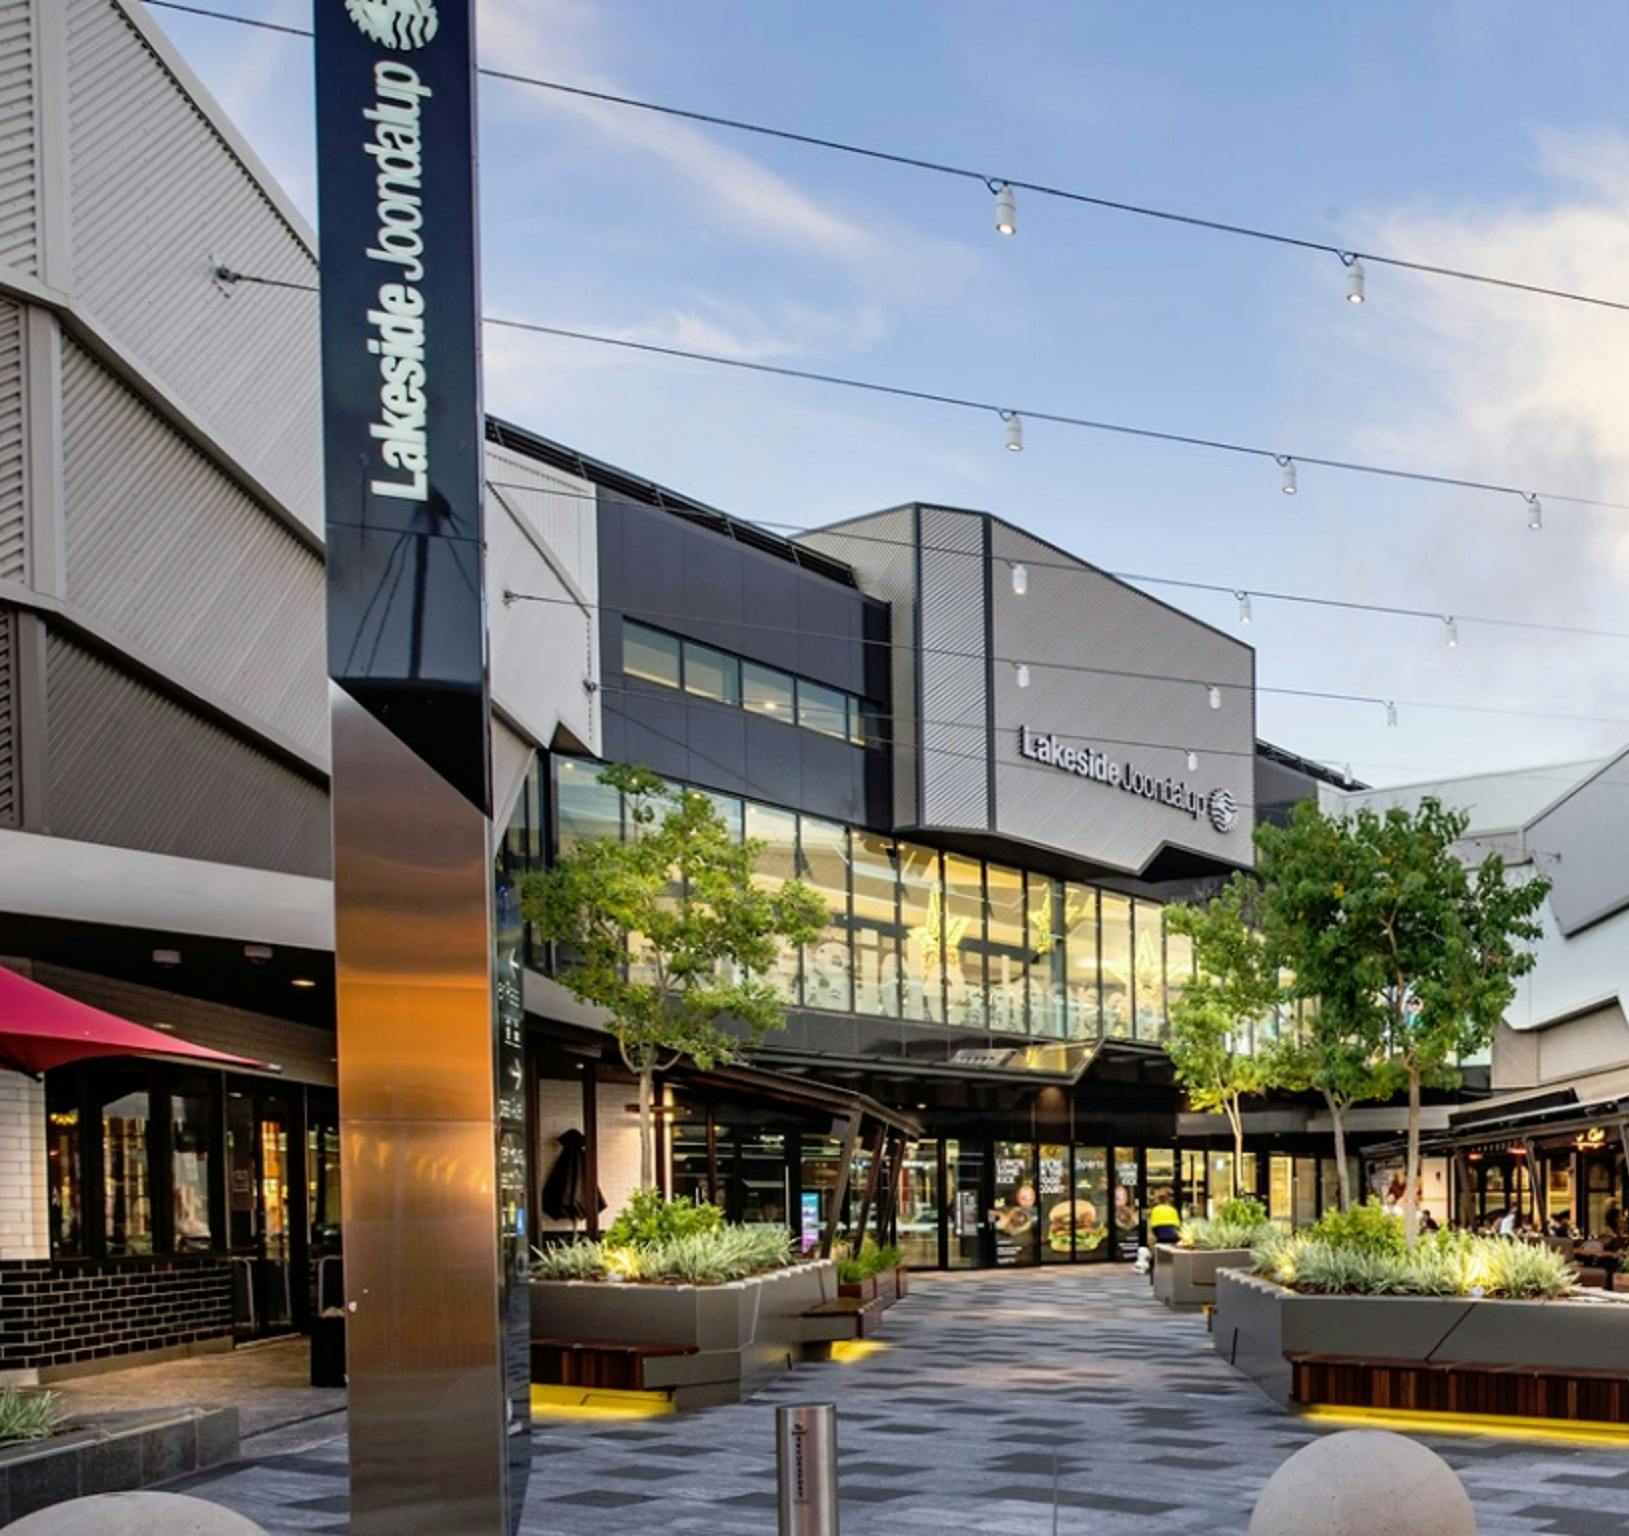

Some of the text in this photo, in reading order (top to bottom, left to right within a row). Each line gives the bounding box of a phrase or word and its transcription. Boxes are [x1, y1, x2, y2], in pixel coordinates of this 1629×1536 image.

[363, 60, 432, 502] Lakeside Joondalup
[1020, 725, 1208, 820] Lakeside Joondalup
